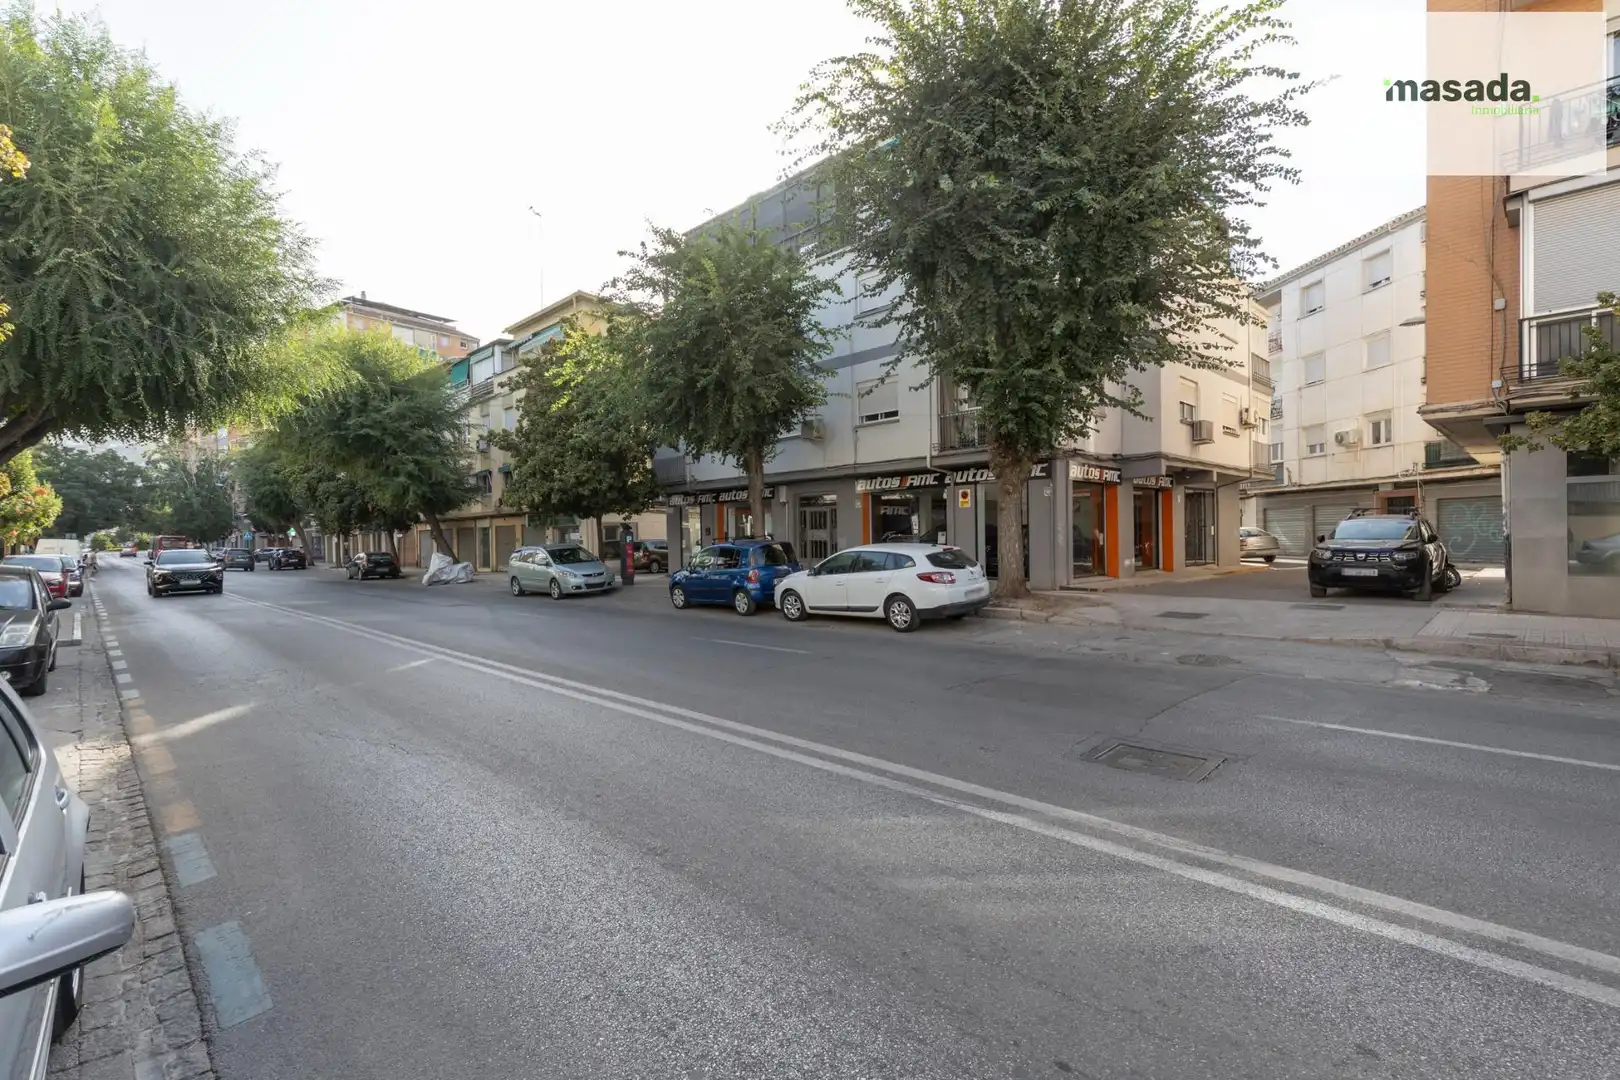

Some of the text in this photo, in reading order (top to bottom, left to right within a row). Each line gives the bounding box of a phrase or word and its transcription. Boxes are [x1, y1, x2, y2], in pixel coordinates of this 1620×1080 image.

[1069, 464, 1101, 480] autos
[856, 476, 901, 491] autos
[719, 489, 749, 501] autos
